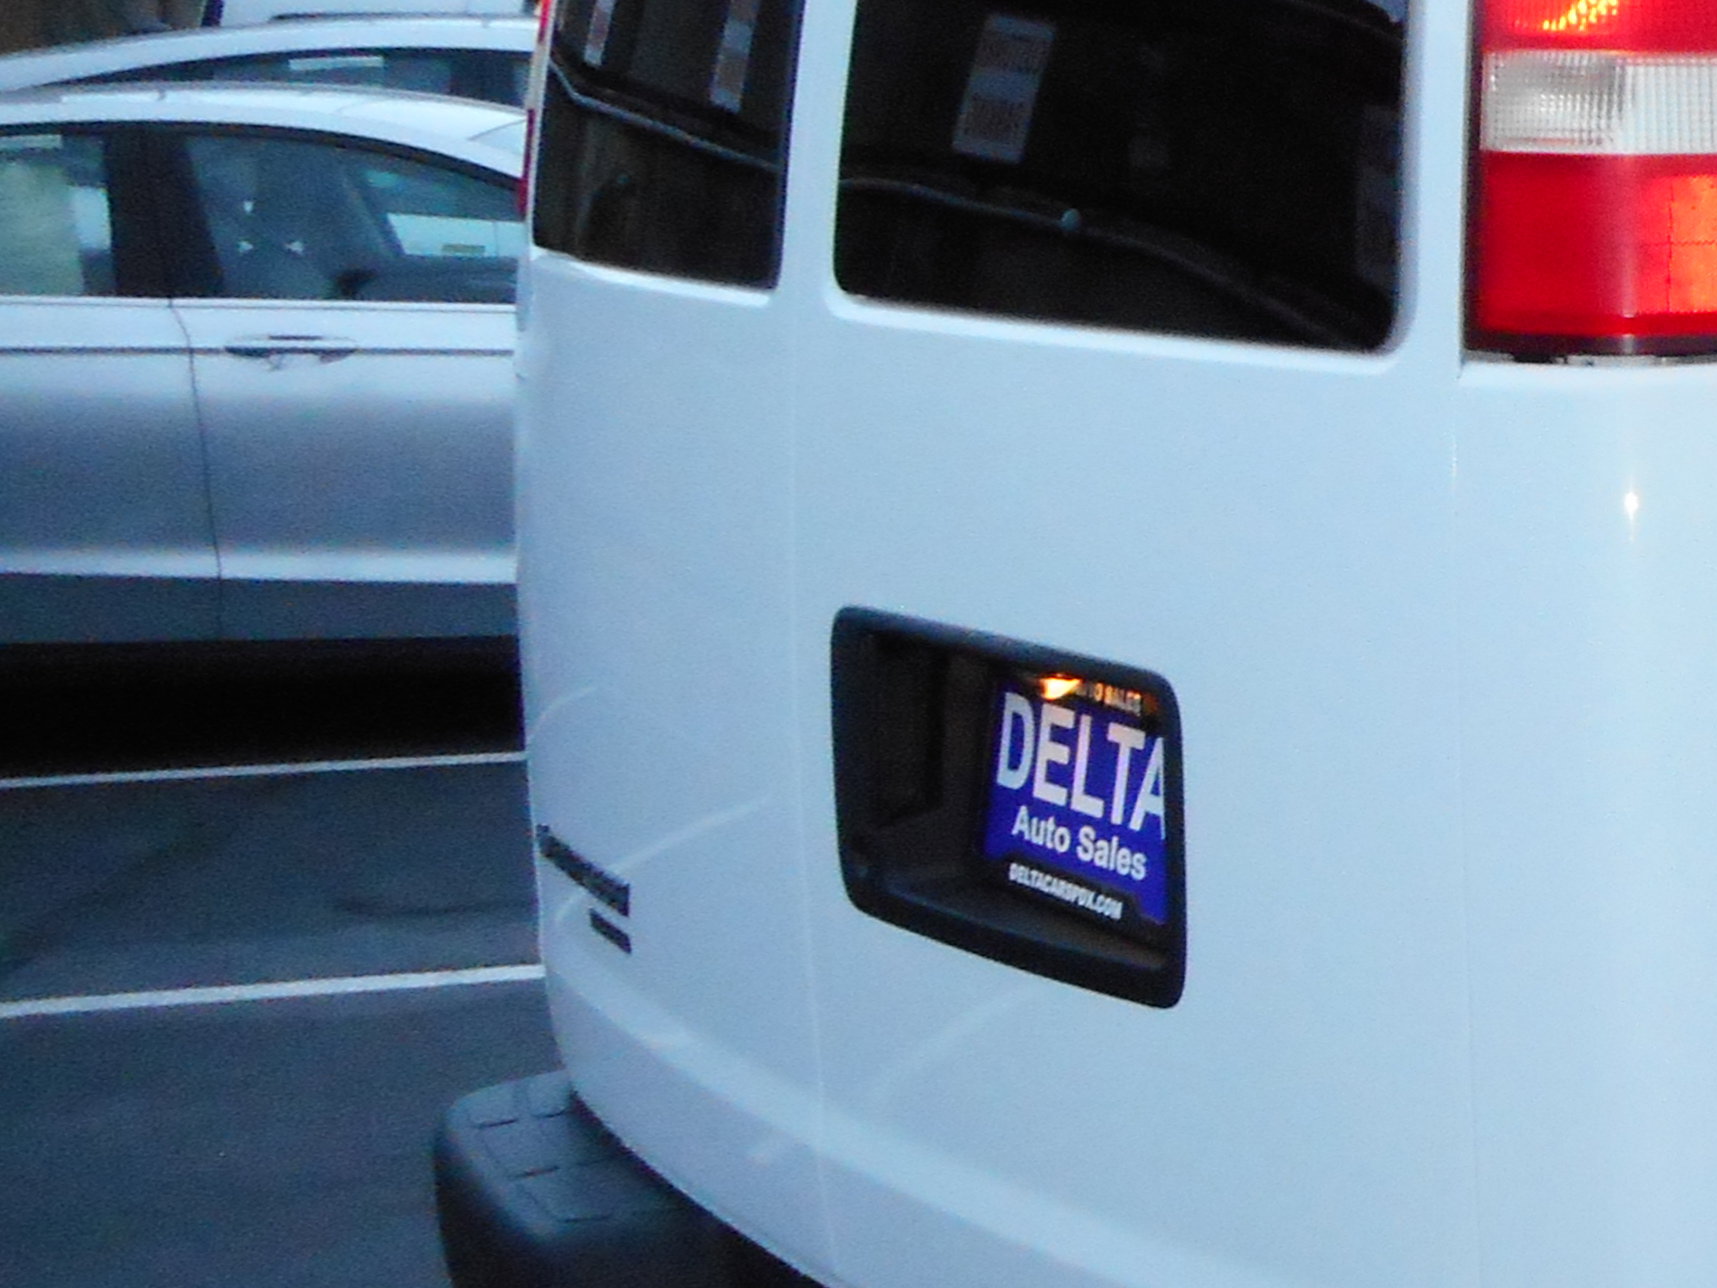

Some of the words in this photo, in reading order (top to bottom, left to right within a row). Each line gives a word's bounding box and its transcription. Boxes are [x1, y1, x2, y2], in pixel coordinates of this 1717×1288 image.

[997, 692, 1166, 841] DELTA
[1011, 805, 1071, 854] Auto
[1076, 825, 1147, 881] Sales
